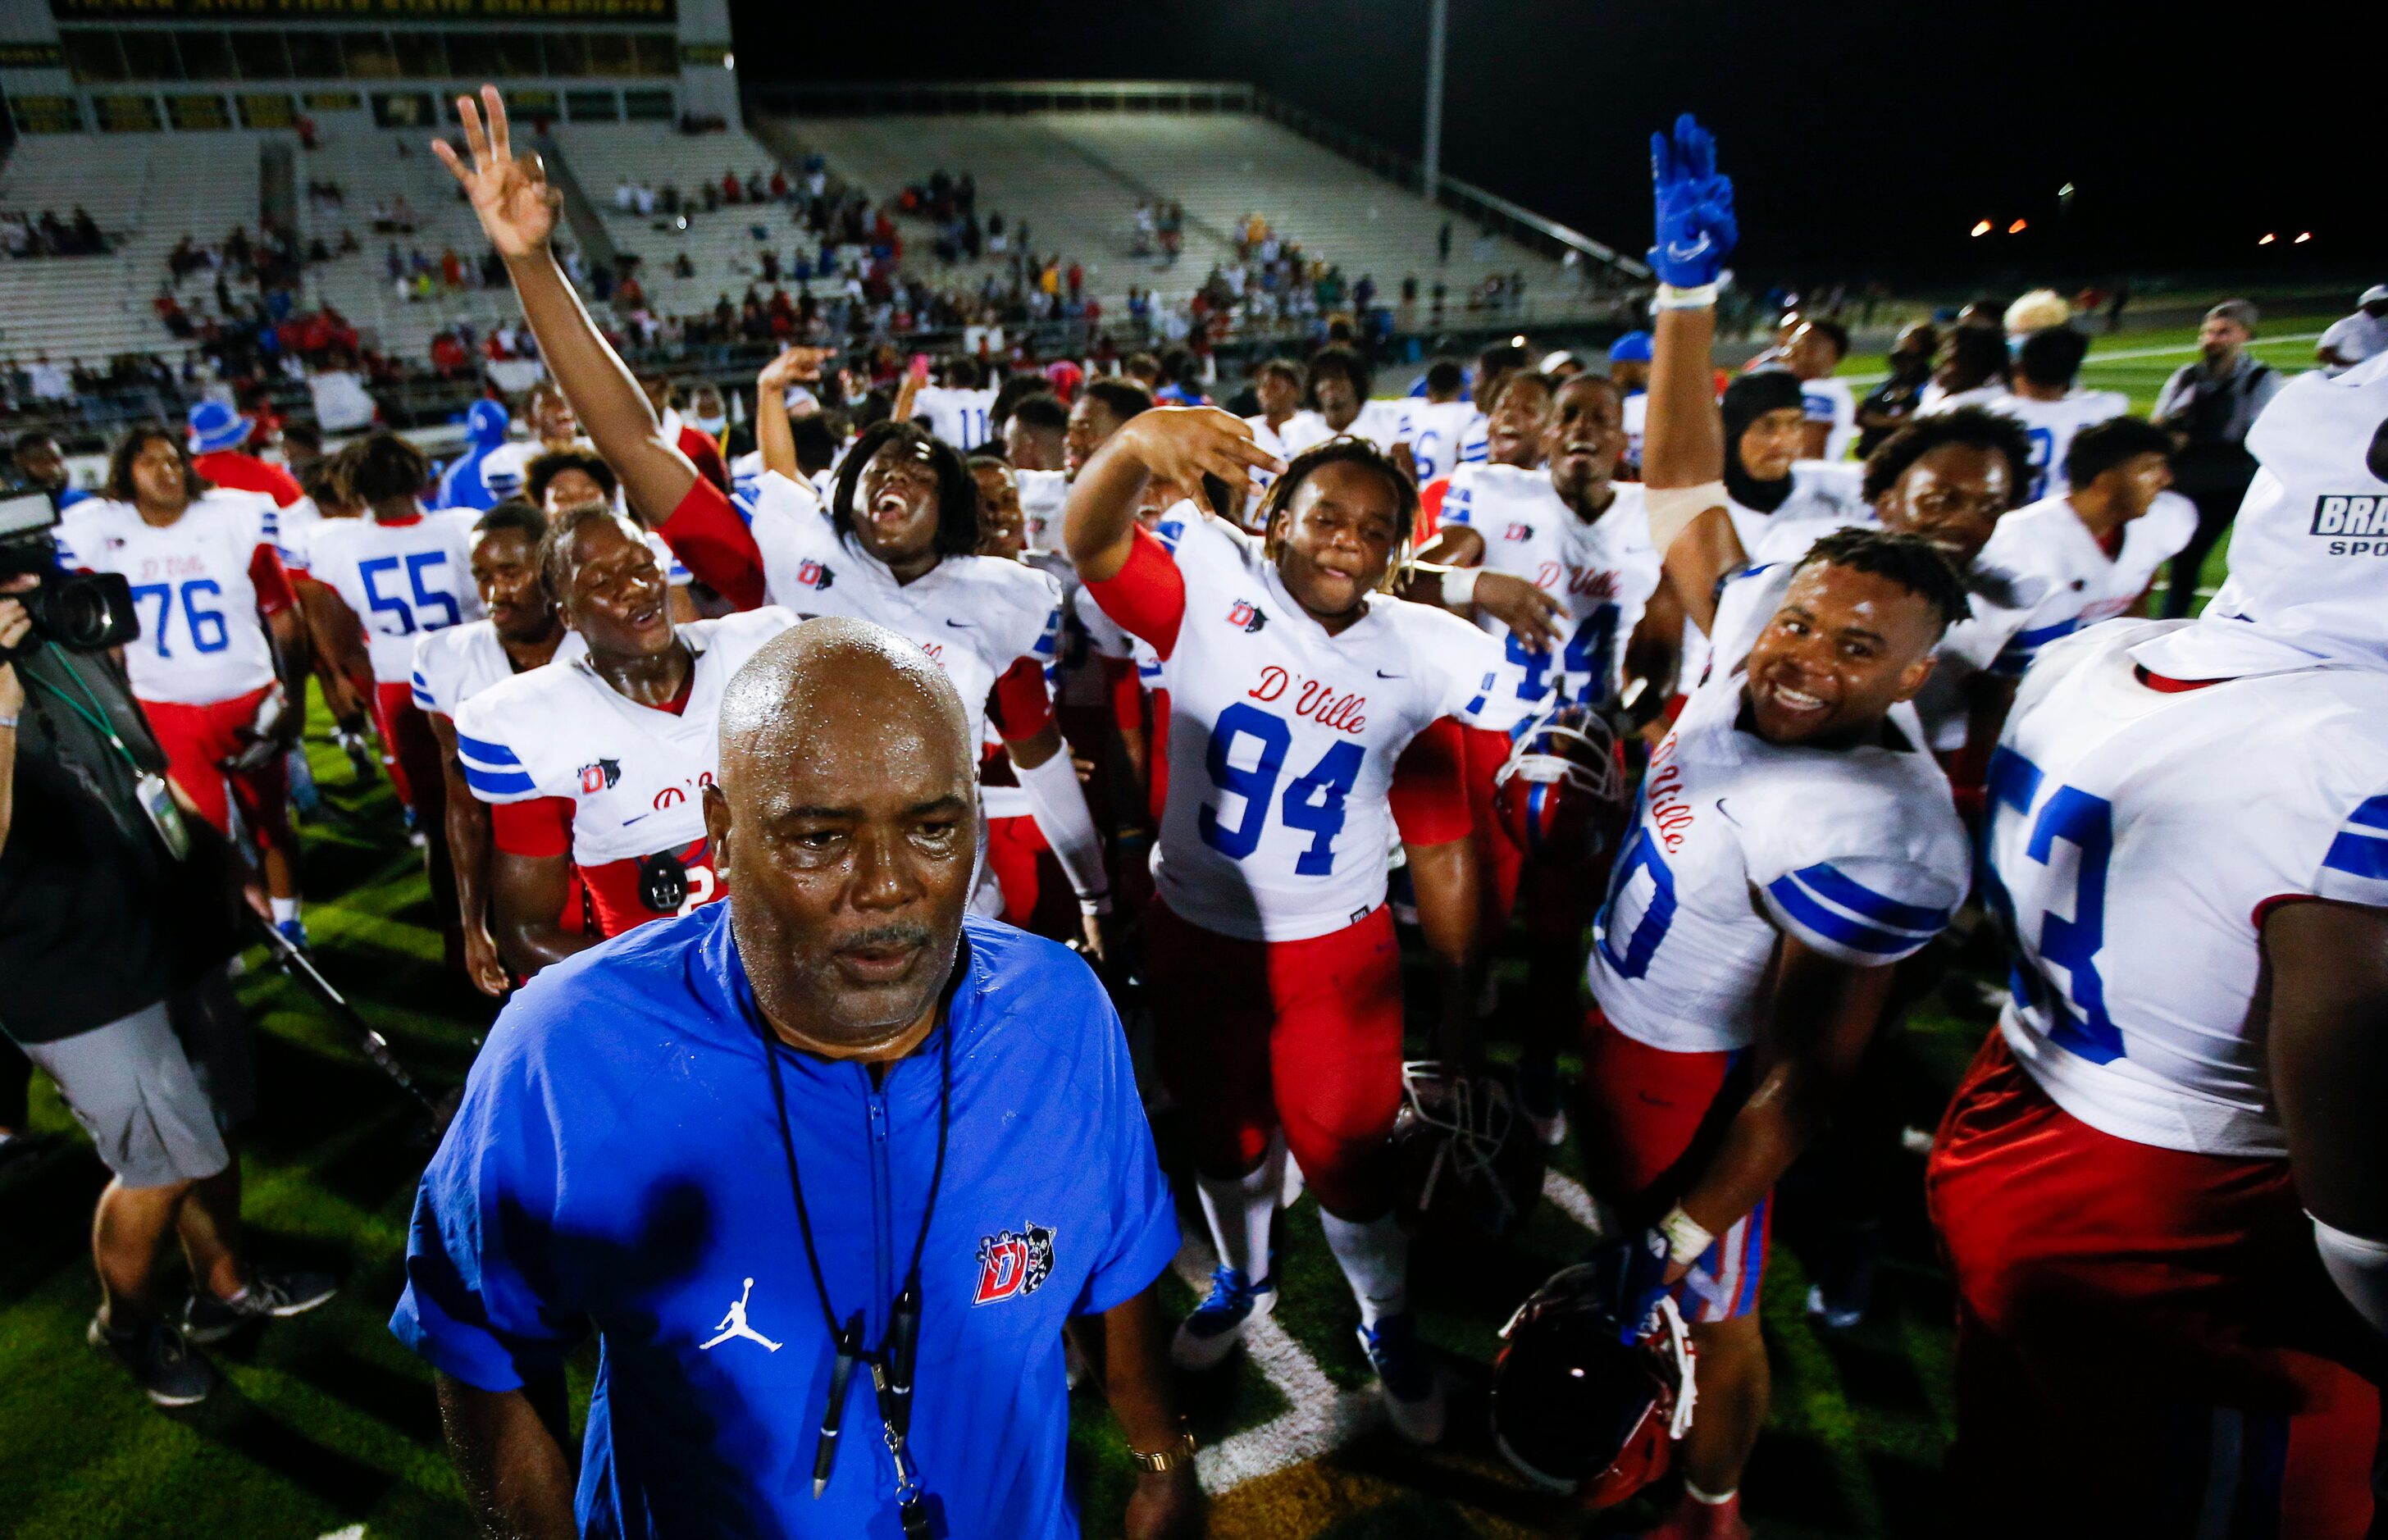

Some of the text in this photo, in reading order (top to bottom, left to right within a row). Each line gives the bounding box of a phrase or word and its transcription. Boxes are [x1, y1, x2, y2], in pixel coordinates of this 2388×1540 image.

[130, 579, 229, 658] 76
[358, 550, 463, 636] 55
[1248, 665, 1366, 735] D'Ville
[1199, 701, 1367, 876] 94
